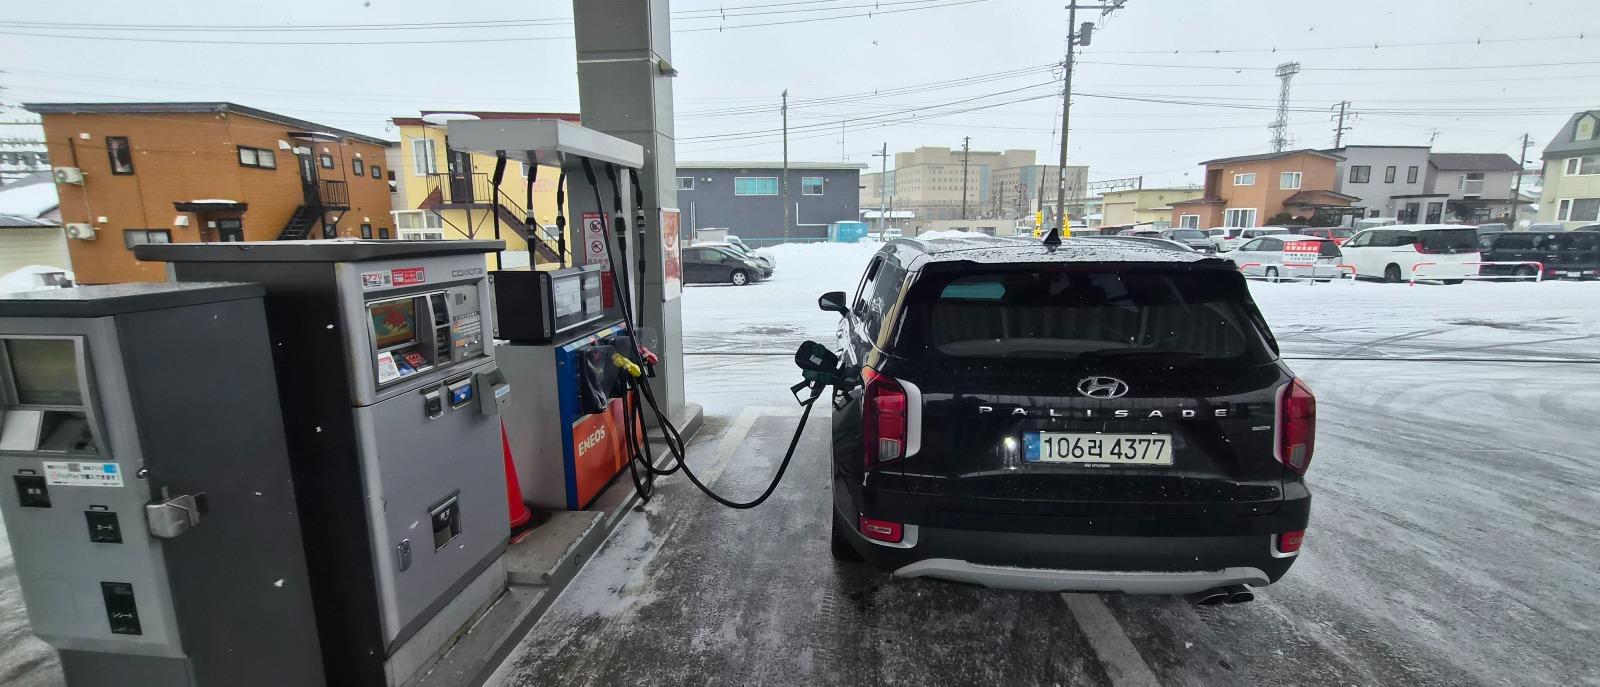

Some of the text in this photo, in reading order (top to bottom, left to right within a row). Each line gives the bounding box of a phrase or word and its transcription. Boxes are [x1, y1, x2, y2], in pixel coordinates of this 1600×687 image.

[978, 406, 1228, 418] PALISADE
[578, 424, 607, 457] ENEOS
[1043, 437, 1167, 460] 106러 4377
